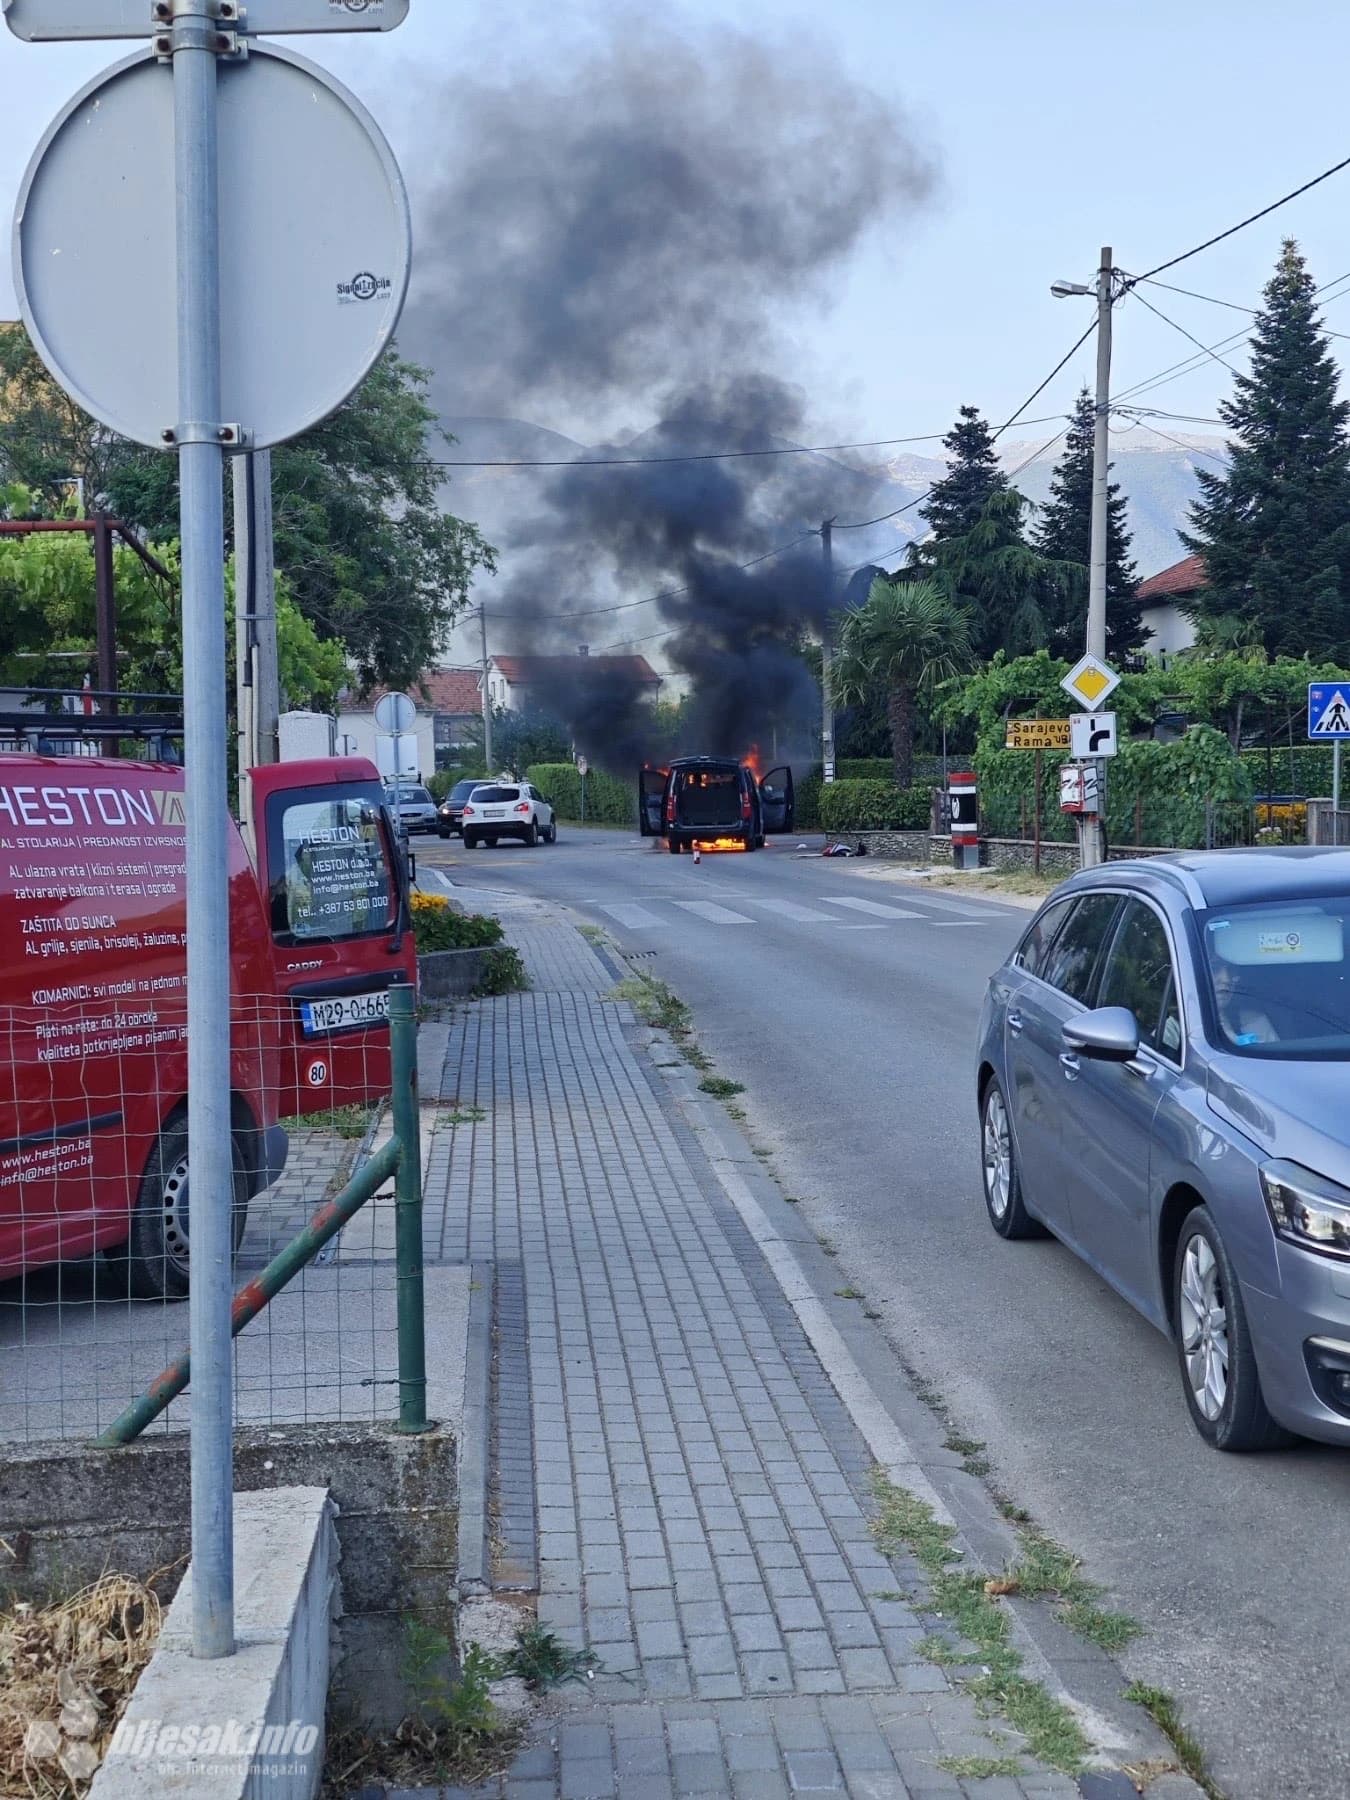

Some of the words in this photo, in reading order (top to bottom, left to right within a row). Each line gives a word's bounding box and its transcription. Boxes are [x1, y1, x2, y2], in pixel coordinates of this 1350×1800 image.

[1014, 723, 1070, 735] Sarajevo
[1014, 736, 1052, 747] Rama
[1, 838, 15, 849] AL
[18, 837, 76, 849] STOLARIJA
[84, 836, 141, 847] PREDANOST
[299, 826, 360, 845] HESTON
[9, 865, 23, 878] AL
[25, 864, 56, 878] ulazna
[58, 865, 85, 877] vrata
[91, 862, 115, 876] klizni
[117, 861, 148, 876] sistemi
[312, 858, 349, 873] HESTON
[311, 870, 375, 884] www.heston.ba
[14, 886, 67, 900] zatvaranje
[69, 882, 104, 897] balkona
[111, 883, 141, 895] terasa
[148, 881, 177, 897] ograde
[313, 880, 379, 894] info@heston.ba
[319, 902, 341, 914] +387
[343, 900, 355, 912] 63
[372, 896, 388, 907] 000
[20, 915, 63, 933] ZAŠTITA
[65, 916, 80, 930] OD
[82, 915, 117, 930] SUNCA
[25, 941, 39, 954] AL
[41, 938, 69, 957] grilje,
[71, 936, 103, 954] sjenila,
[104, 935, 142, 949] brisoleji,
[144, 932, 180, 946] žaluzine,
[32, 985, 91, 1005] KOMARNICI:
[93, 982, 107, 997] svi
[108, 979, 136, 995] modeli
[139, 979, 149, 991] na
[151, 976, 180, 993] jednom
[36, 1022, 60, 1040] Plati
[61, 1026, 74, 1037] na
[75, 1020, 99, 1034] rate:
[114, 1014, 126, 1027] 24
[128, 1011, 158, 1026] obroka
[37, 1043, 81, 1062] kvaliteta
[83, 1033, 143, 1055] potkrijepljena
[145, 1027, 178, 1046] pisanim
[311, 1065, 325, 1082] 80
[2, 1139, 91, 1169] www.heston.ba
[0, 1155, 94, 1187] info@heston.ba
